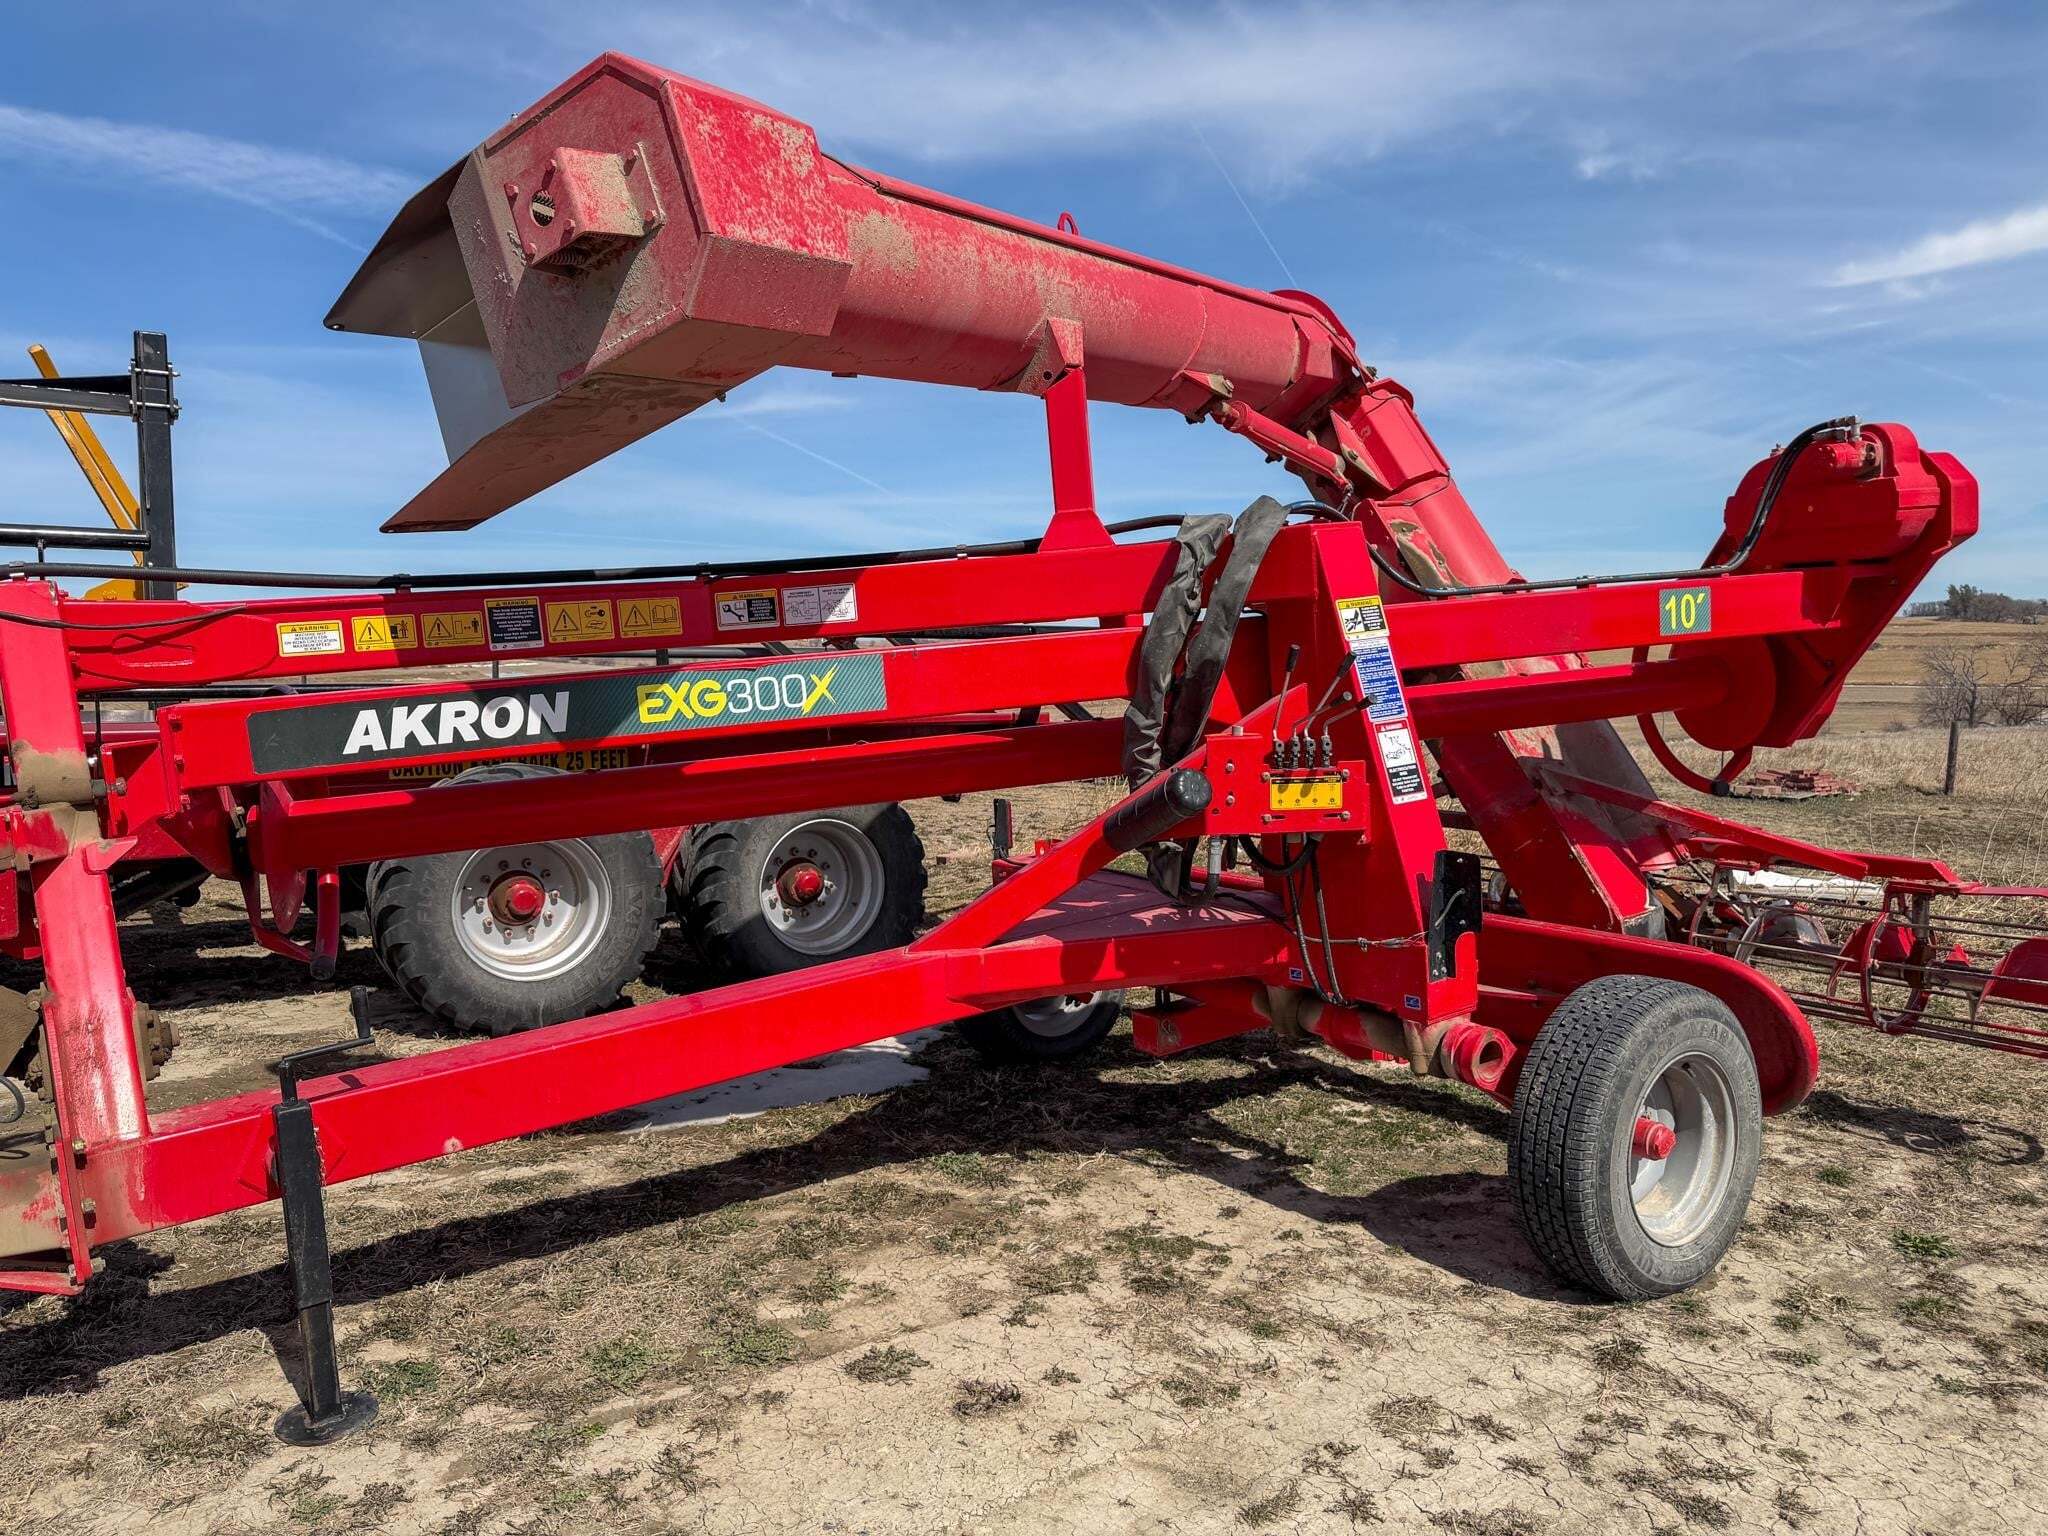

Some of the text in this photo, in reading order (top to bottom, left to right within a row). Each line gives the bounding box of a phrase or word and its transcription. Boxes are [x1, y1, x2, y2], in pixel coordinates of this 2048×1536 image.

[342, 691, 570, 755] AKRON
[636, 663, 839, 724] EXG300X
[567, 751, 584, 771] 25
[591, 749, 627, 769] FEET
